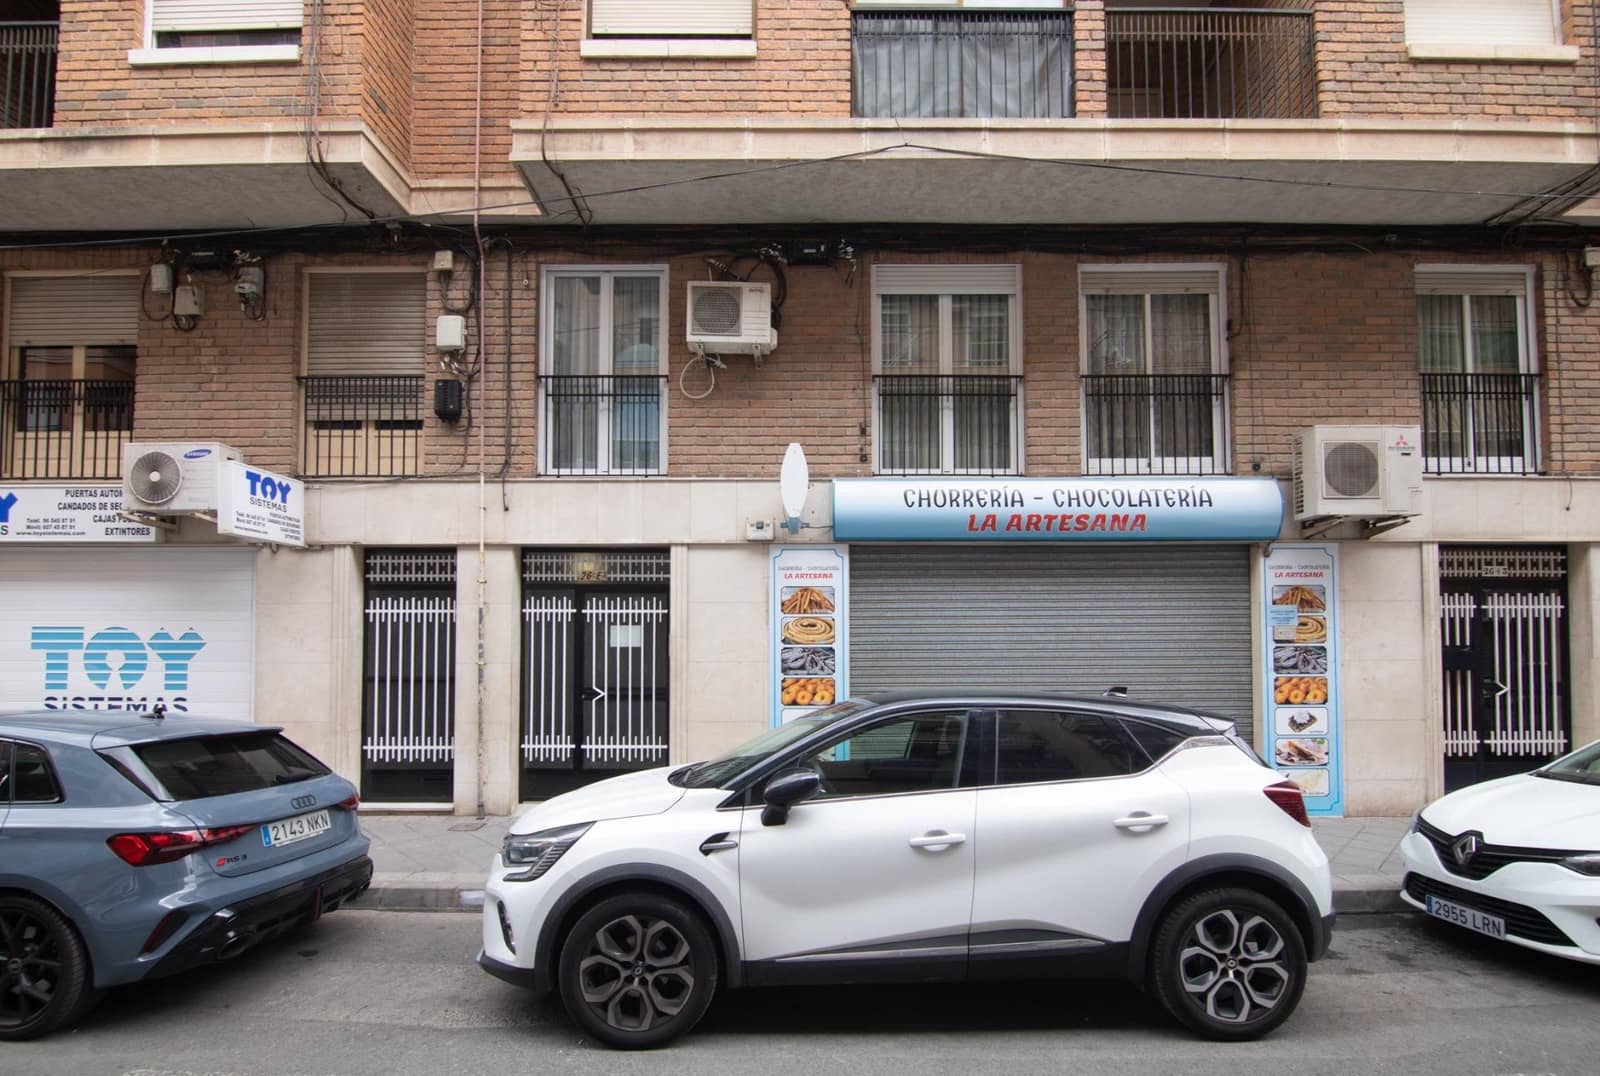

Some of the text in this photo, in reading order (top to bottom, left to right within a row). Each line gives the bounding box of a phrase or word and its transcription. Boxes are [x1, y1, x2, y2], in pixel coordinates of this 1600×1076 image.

[65, 489, 98, 498] PUERTAS
[246, 471, 291, 504] TOY
[903, 486, 1025, 508] CHURRERÍA
[1052, 485, 1214, 508] CHOCOLATERÍA
[57, 502, 97, 511] CANDADOS
[98, 502, 108, 511] DE
[93, 514, 116, 523] CAJAS
[967, 513, 1148, 532] LA ARTESANA
[105, 527, 151, 536] EXTINTORES
[31, 627, 207, 690] TOY
[44, 696, 188, 711] SISTEMAS
[271, 813, 329, 841] 2143 NKN
[1434, 900, 1501, 937] 2955 LRN
